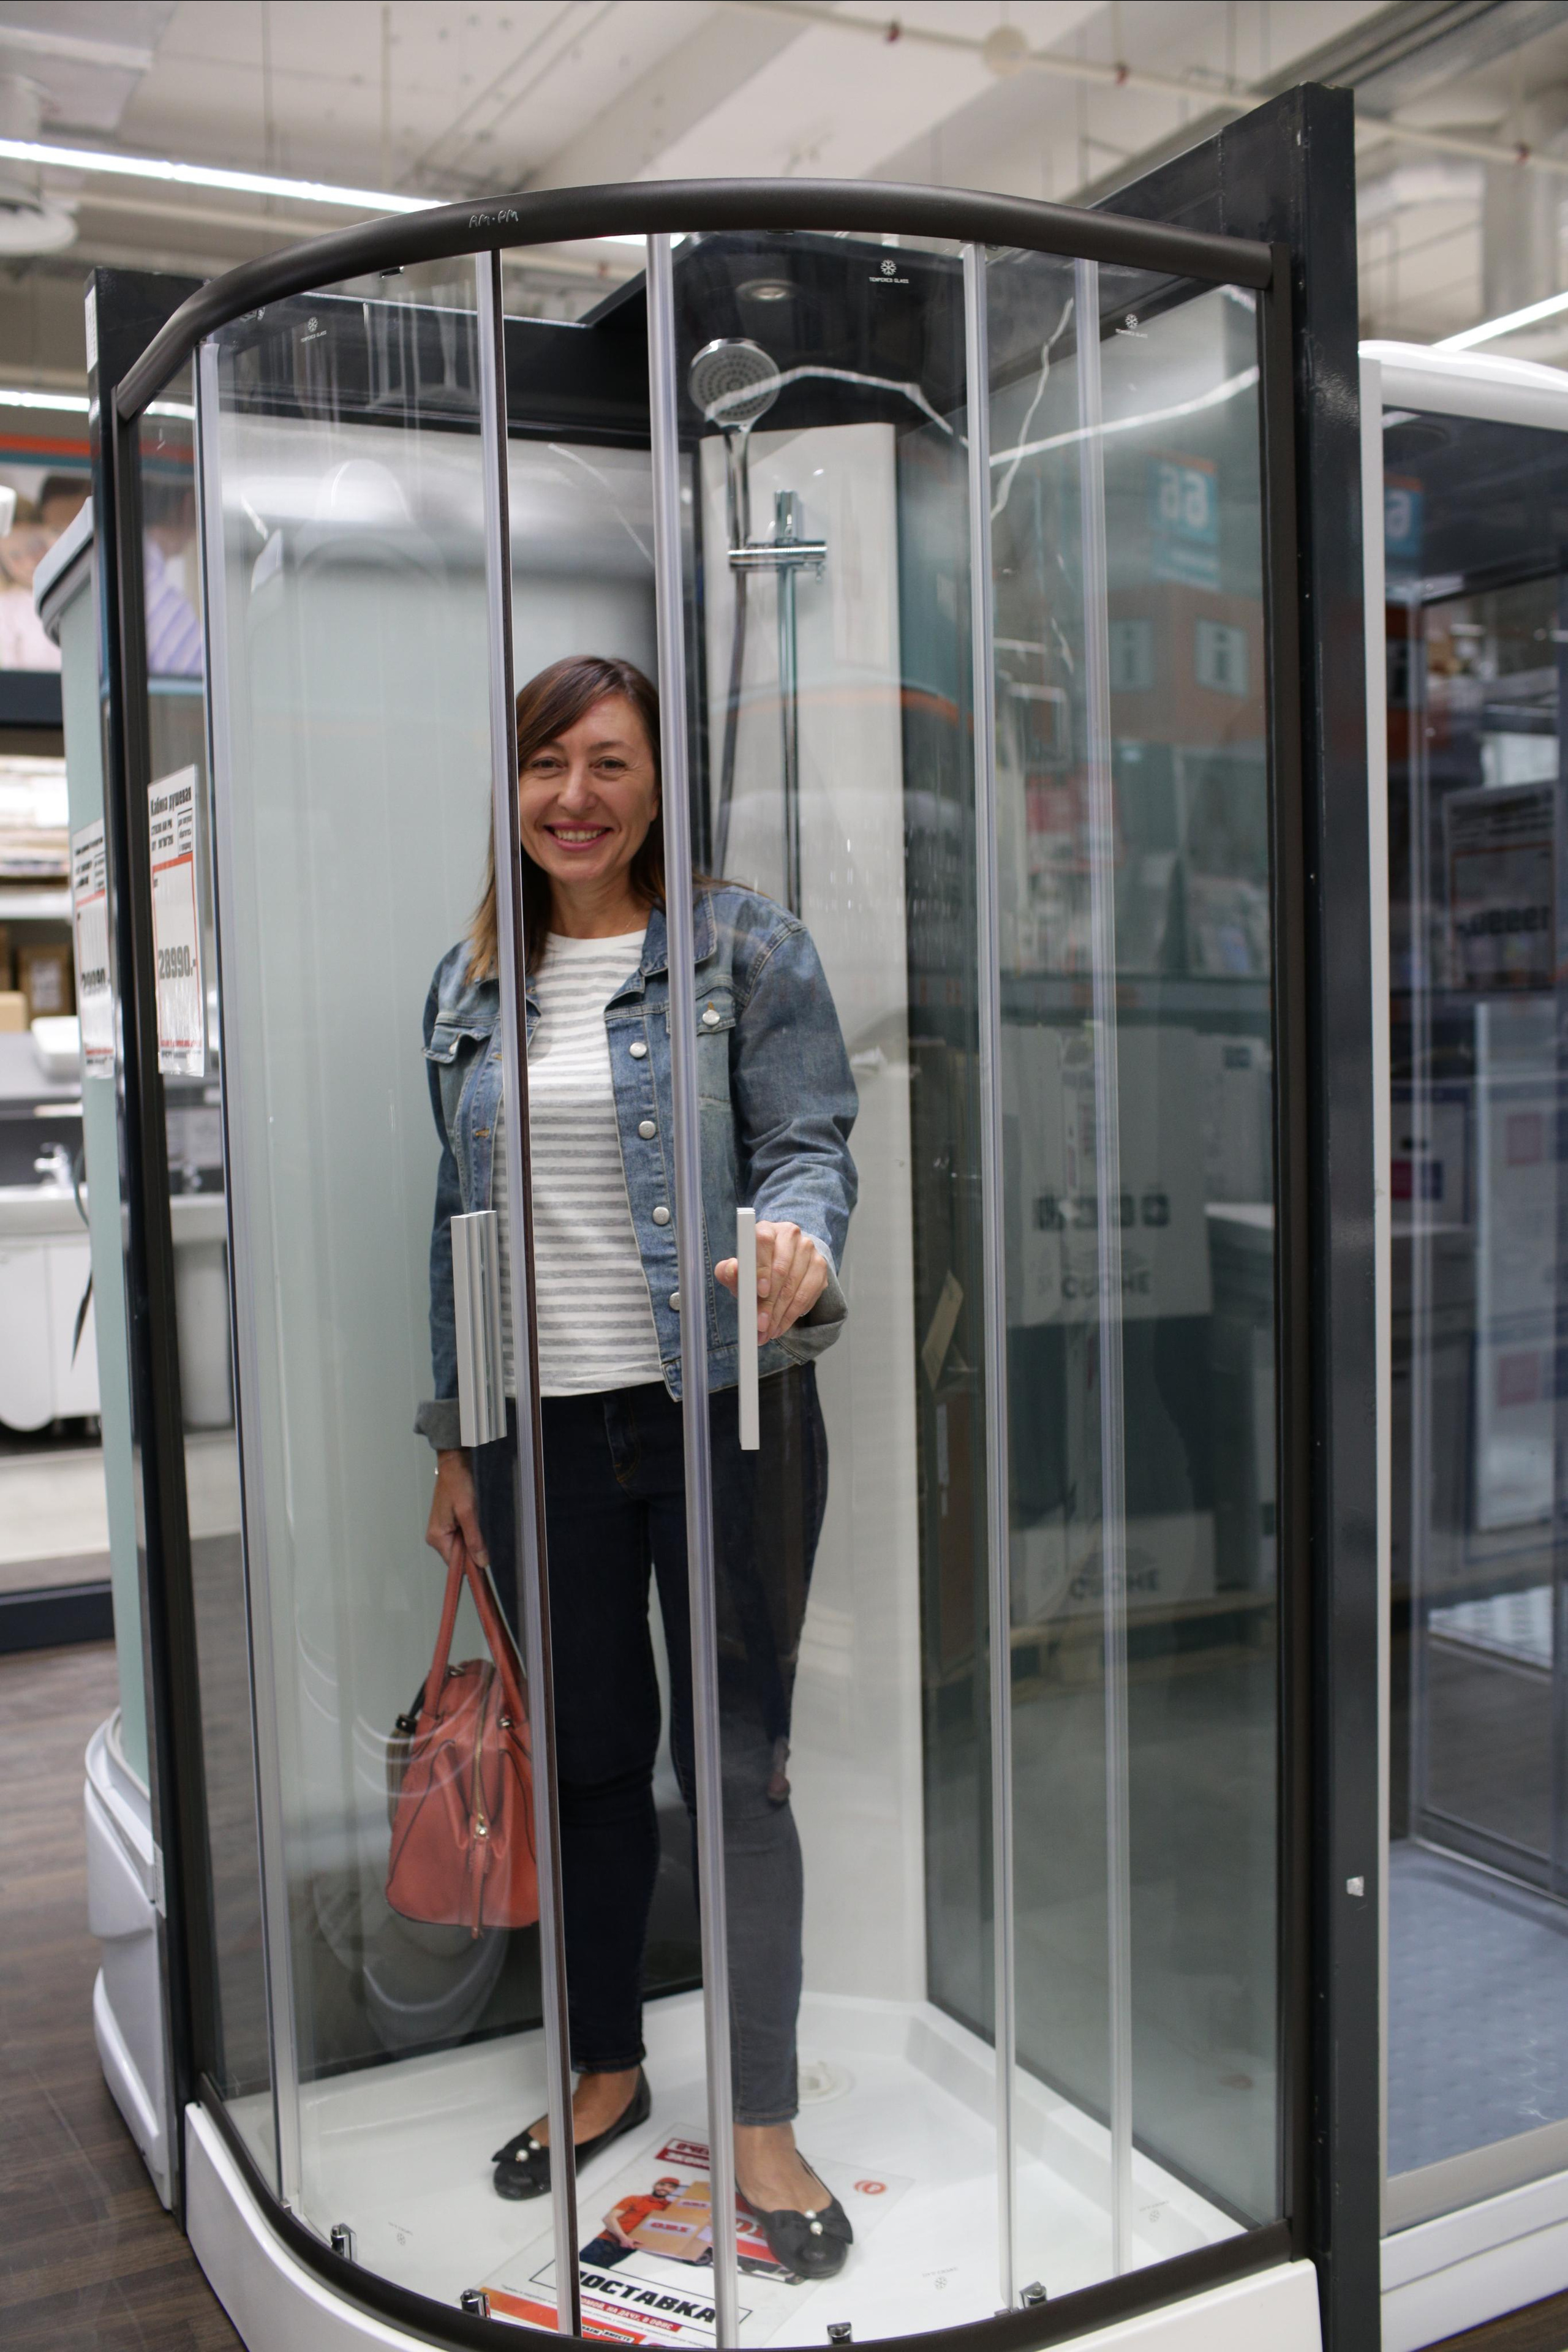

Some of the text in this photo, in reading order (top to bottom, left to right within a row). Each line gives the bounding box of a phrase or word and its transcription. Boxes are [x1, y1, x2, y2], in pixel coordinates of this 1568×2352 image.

[168, 786, 192, 812] душевая
[580, 2271, 716, 2323] ОСТАВКА
[606, 2305, 618, 2315] НА
